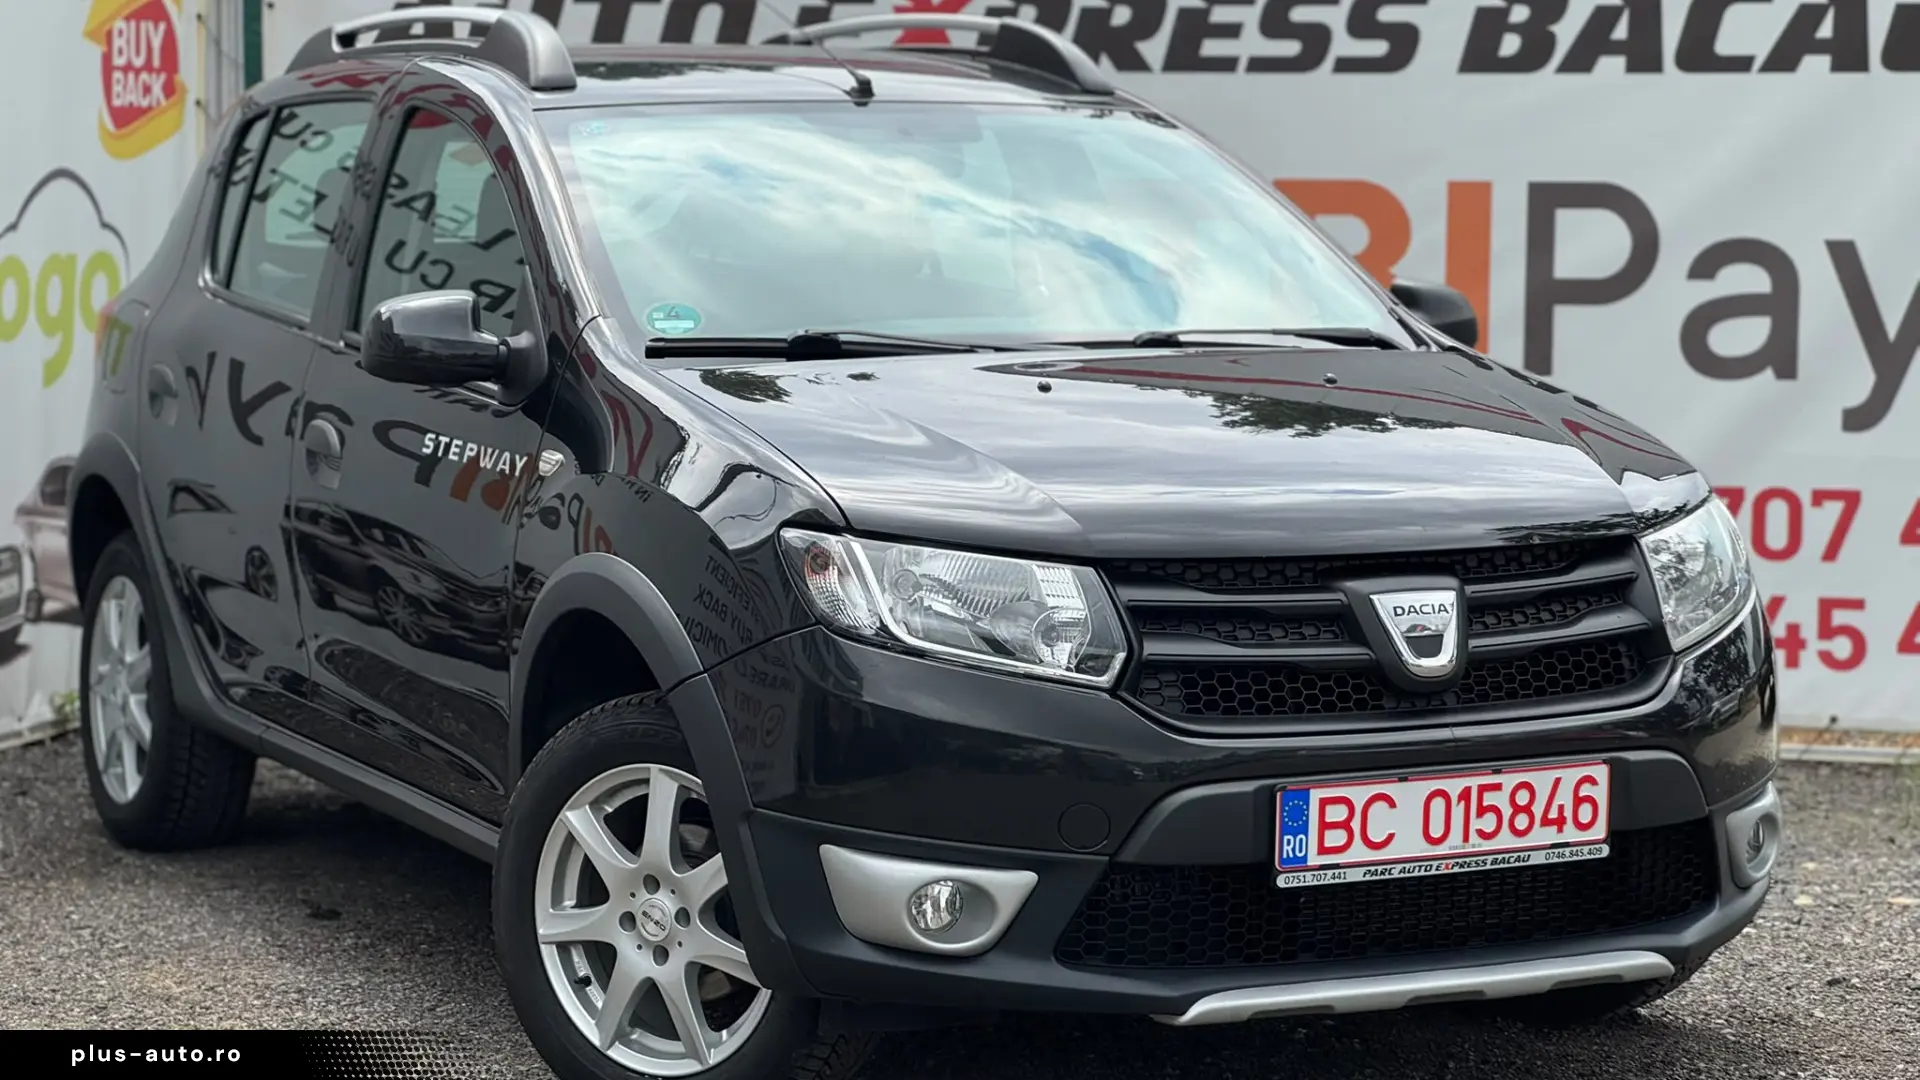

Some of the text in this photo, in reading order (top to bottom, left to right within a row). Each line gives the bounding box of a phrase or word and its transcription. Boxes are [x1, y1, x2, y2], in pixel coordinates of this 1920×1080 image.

[112, 19, 167, 69] BUY
[111, 69, 168, 108] BACK
[421, 432, 529, 477] STEPWAY
[1393, 603, 1450, 617] DACIA
[1317, 774, 1600, 856] BC 015846
[1283, 834, 1307, 859] RO
[1284, 846, 1604, 886] 0751.707.441 PARC AUTO EXPRESS BACAU 0746.845.409
